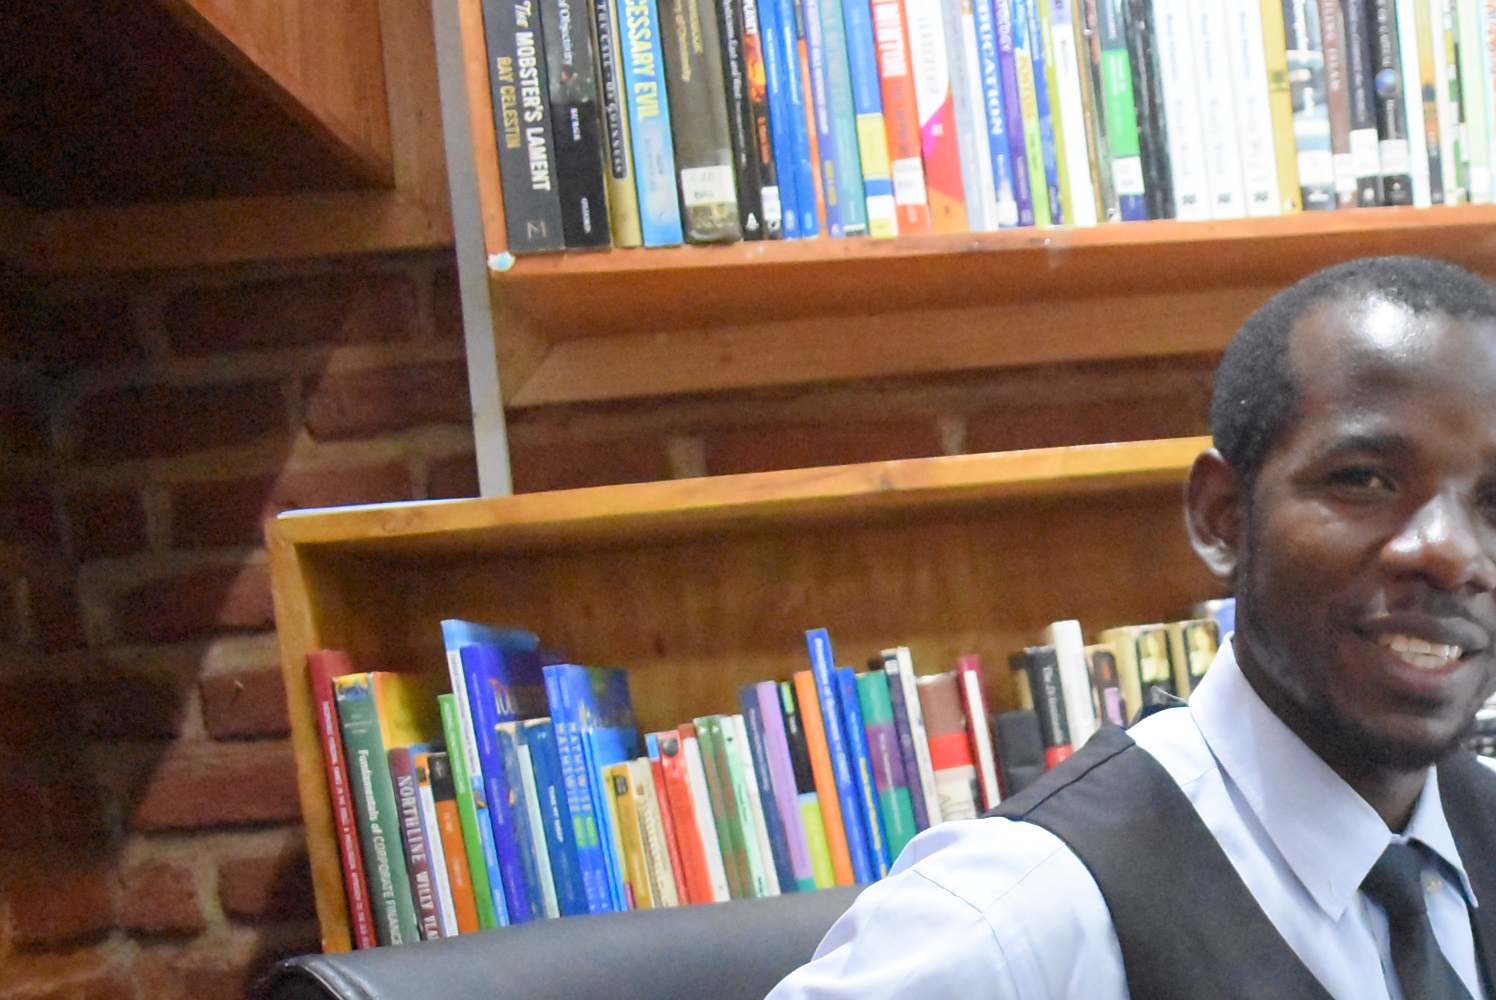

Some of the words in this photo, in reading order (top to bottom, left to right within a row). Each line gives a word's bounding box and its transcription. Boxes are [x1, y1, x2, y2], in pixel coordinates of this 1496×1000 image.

[496, 56, 513, 83] RAY
[514, 30, 542, 122] MOBSTER'S
[917, 15, 940, 95] LEADERSHIP
[499, 84, 520, 148] CELESTIN
[633, 79, 658, 121] EVIL
[525, 125, 551, 193] LAMENT
[356, 748, 380, 821] Fundamentals
[555, 722, 579, 812] MATHSWISE
[566, 721, 591, 811] MATHSWISE
[371, 822, 382, 834] of
[397, 775, 426, 863] NORTHLINE
[415, 871, 433, 910] WILLY
[372, 835, 394, 898] CORPORATE
[383, 899, 403, 945] FINANCE
